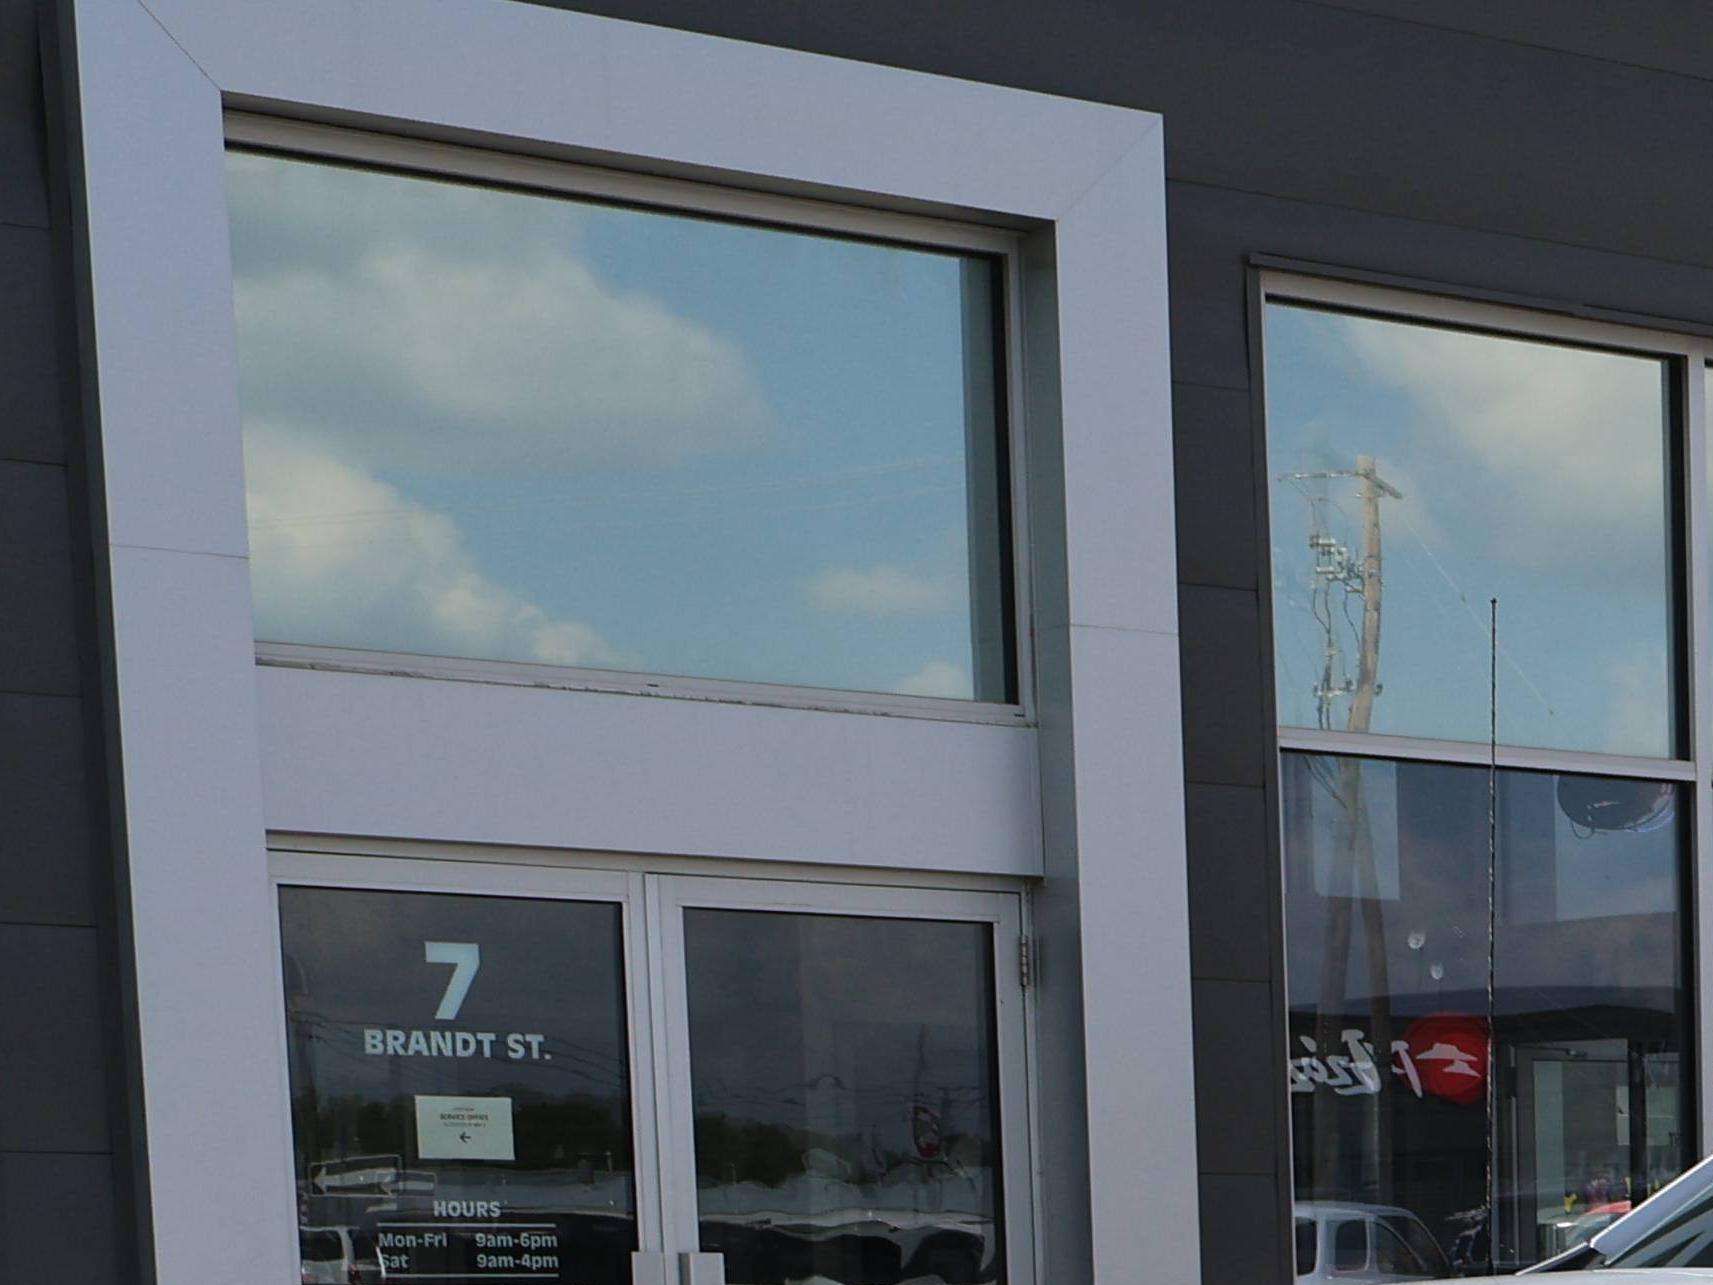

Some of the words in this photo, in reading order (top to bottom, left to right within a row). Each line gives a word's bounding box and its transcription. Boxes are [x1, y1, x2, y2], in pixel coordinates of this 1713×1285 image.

[424, 942, 480, 1020] 7
[364, 1028, 496, 1058] BRANDT
[507, 1033, 552, 1060] ST.
[433, 1200, 501, 1218] HOURS
[378, 1233, 447, 1248] Mon-Fri
[475, 1232, 558, 1249] 9am-6pm
[380, 1254, 409, 1269] Sat
[477, 1254, 559, 1270] 9am-4pm
